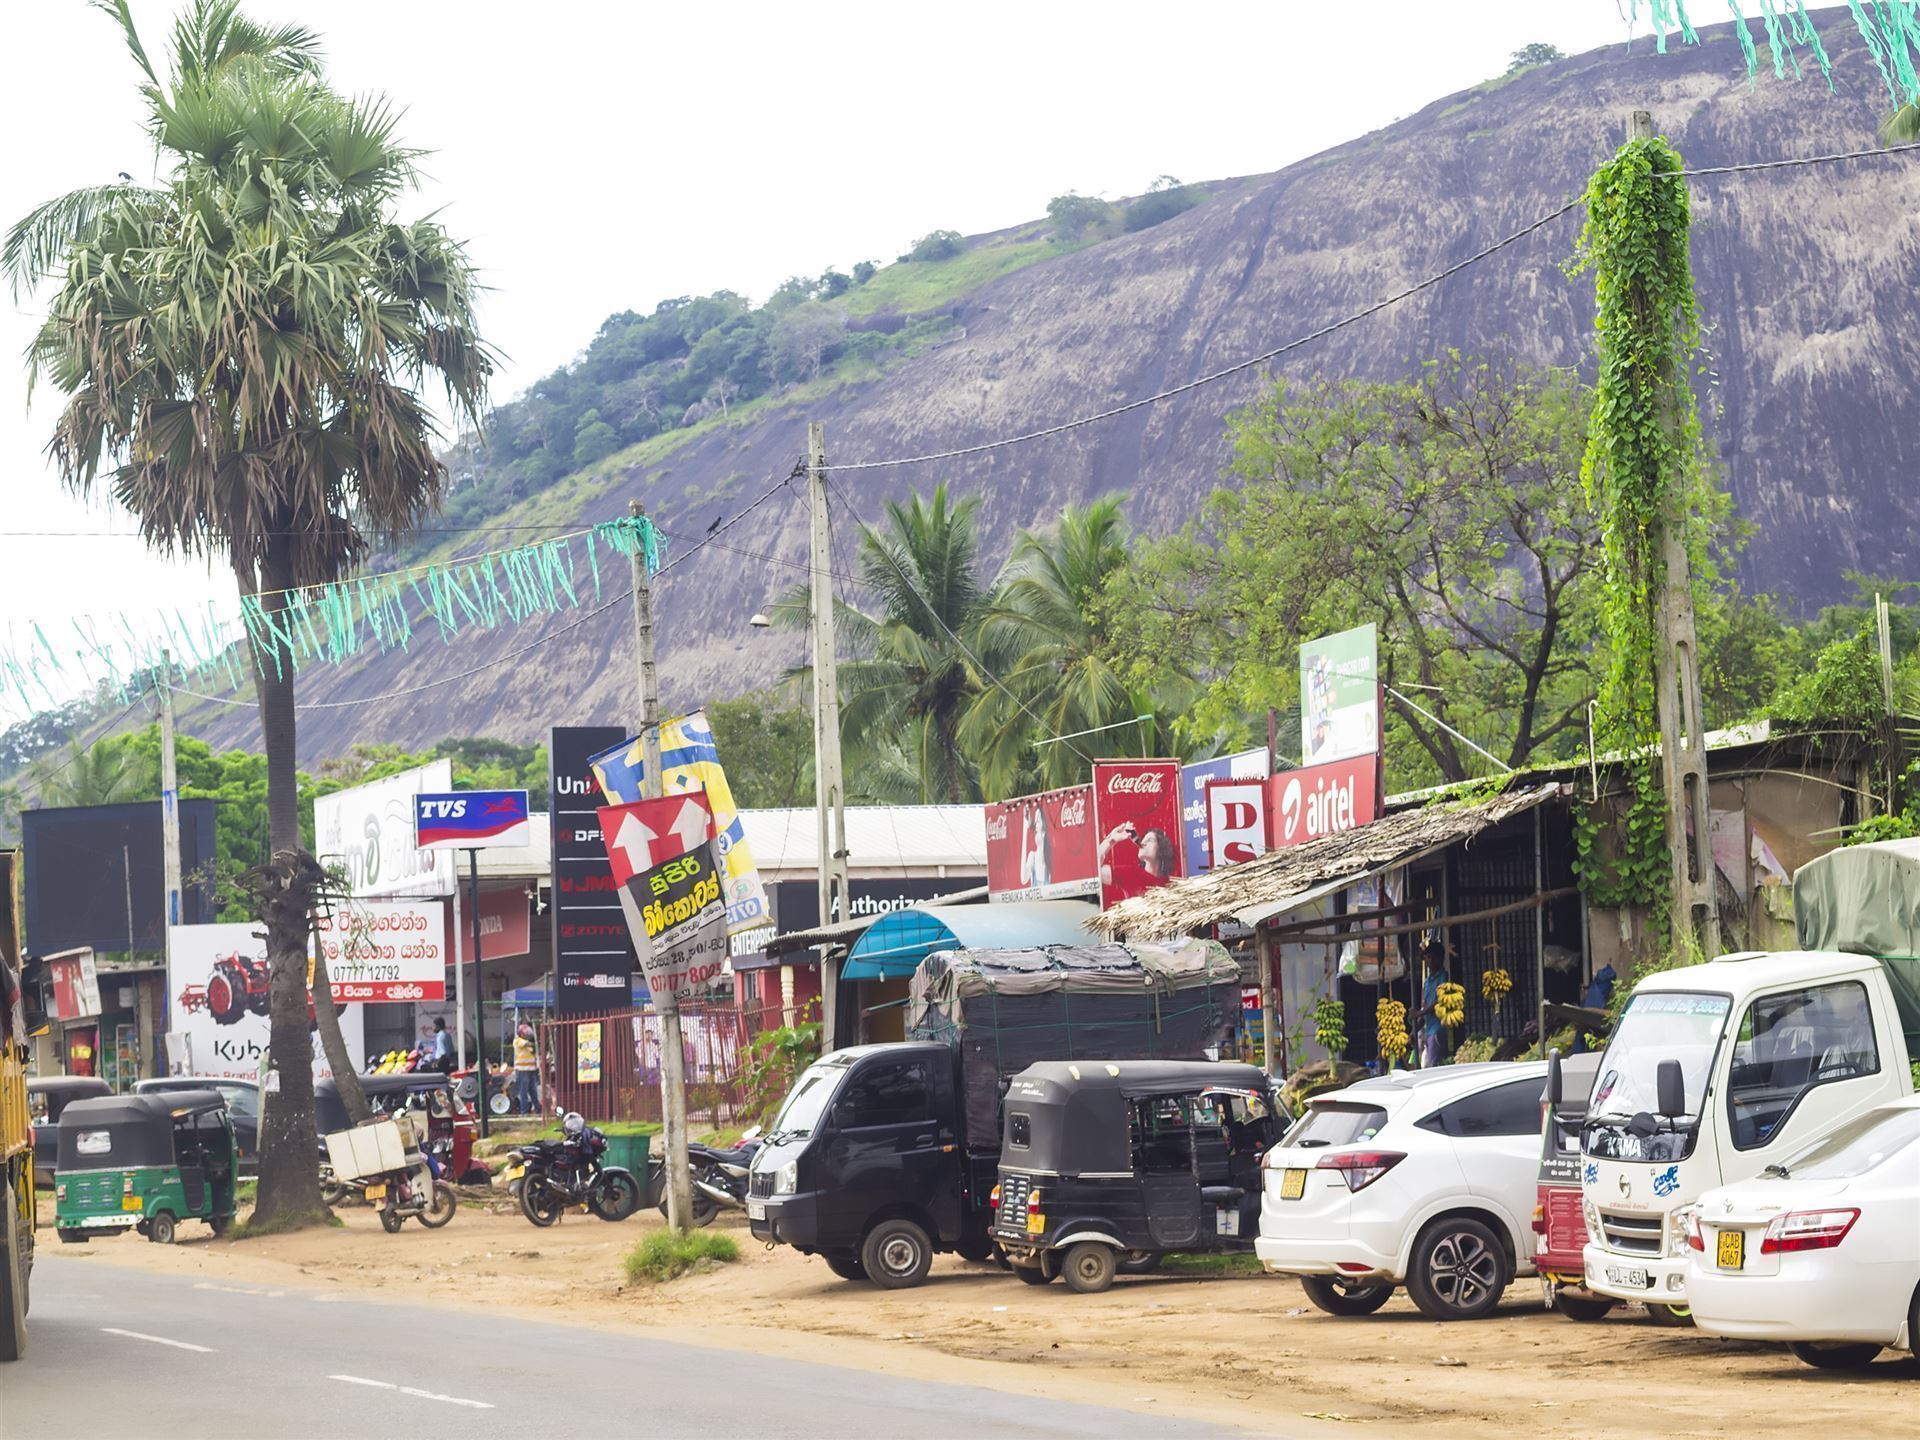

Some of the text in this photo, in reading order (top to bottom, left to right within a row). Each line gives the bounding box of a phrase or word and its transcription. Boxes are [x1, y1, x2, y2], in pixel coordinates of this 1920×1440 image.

[420, 800, 467, 818] TVS
[1306, 774, 1356, 836] airtel
[1604, 1137, 1641, 1157] KAMA
[1725, 1233, 1740, 1249] CAB
[1721, 1250, 1740, 1266] 4067
